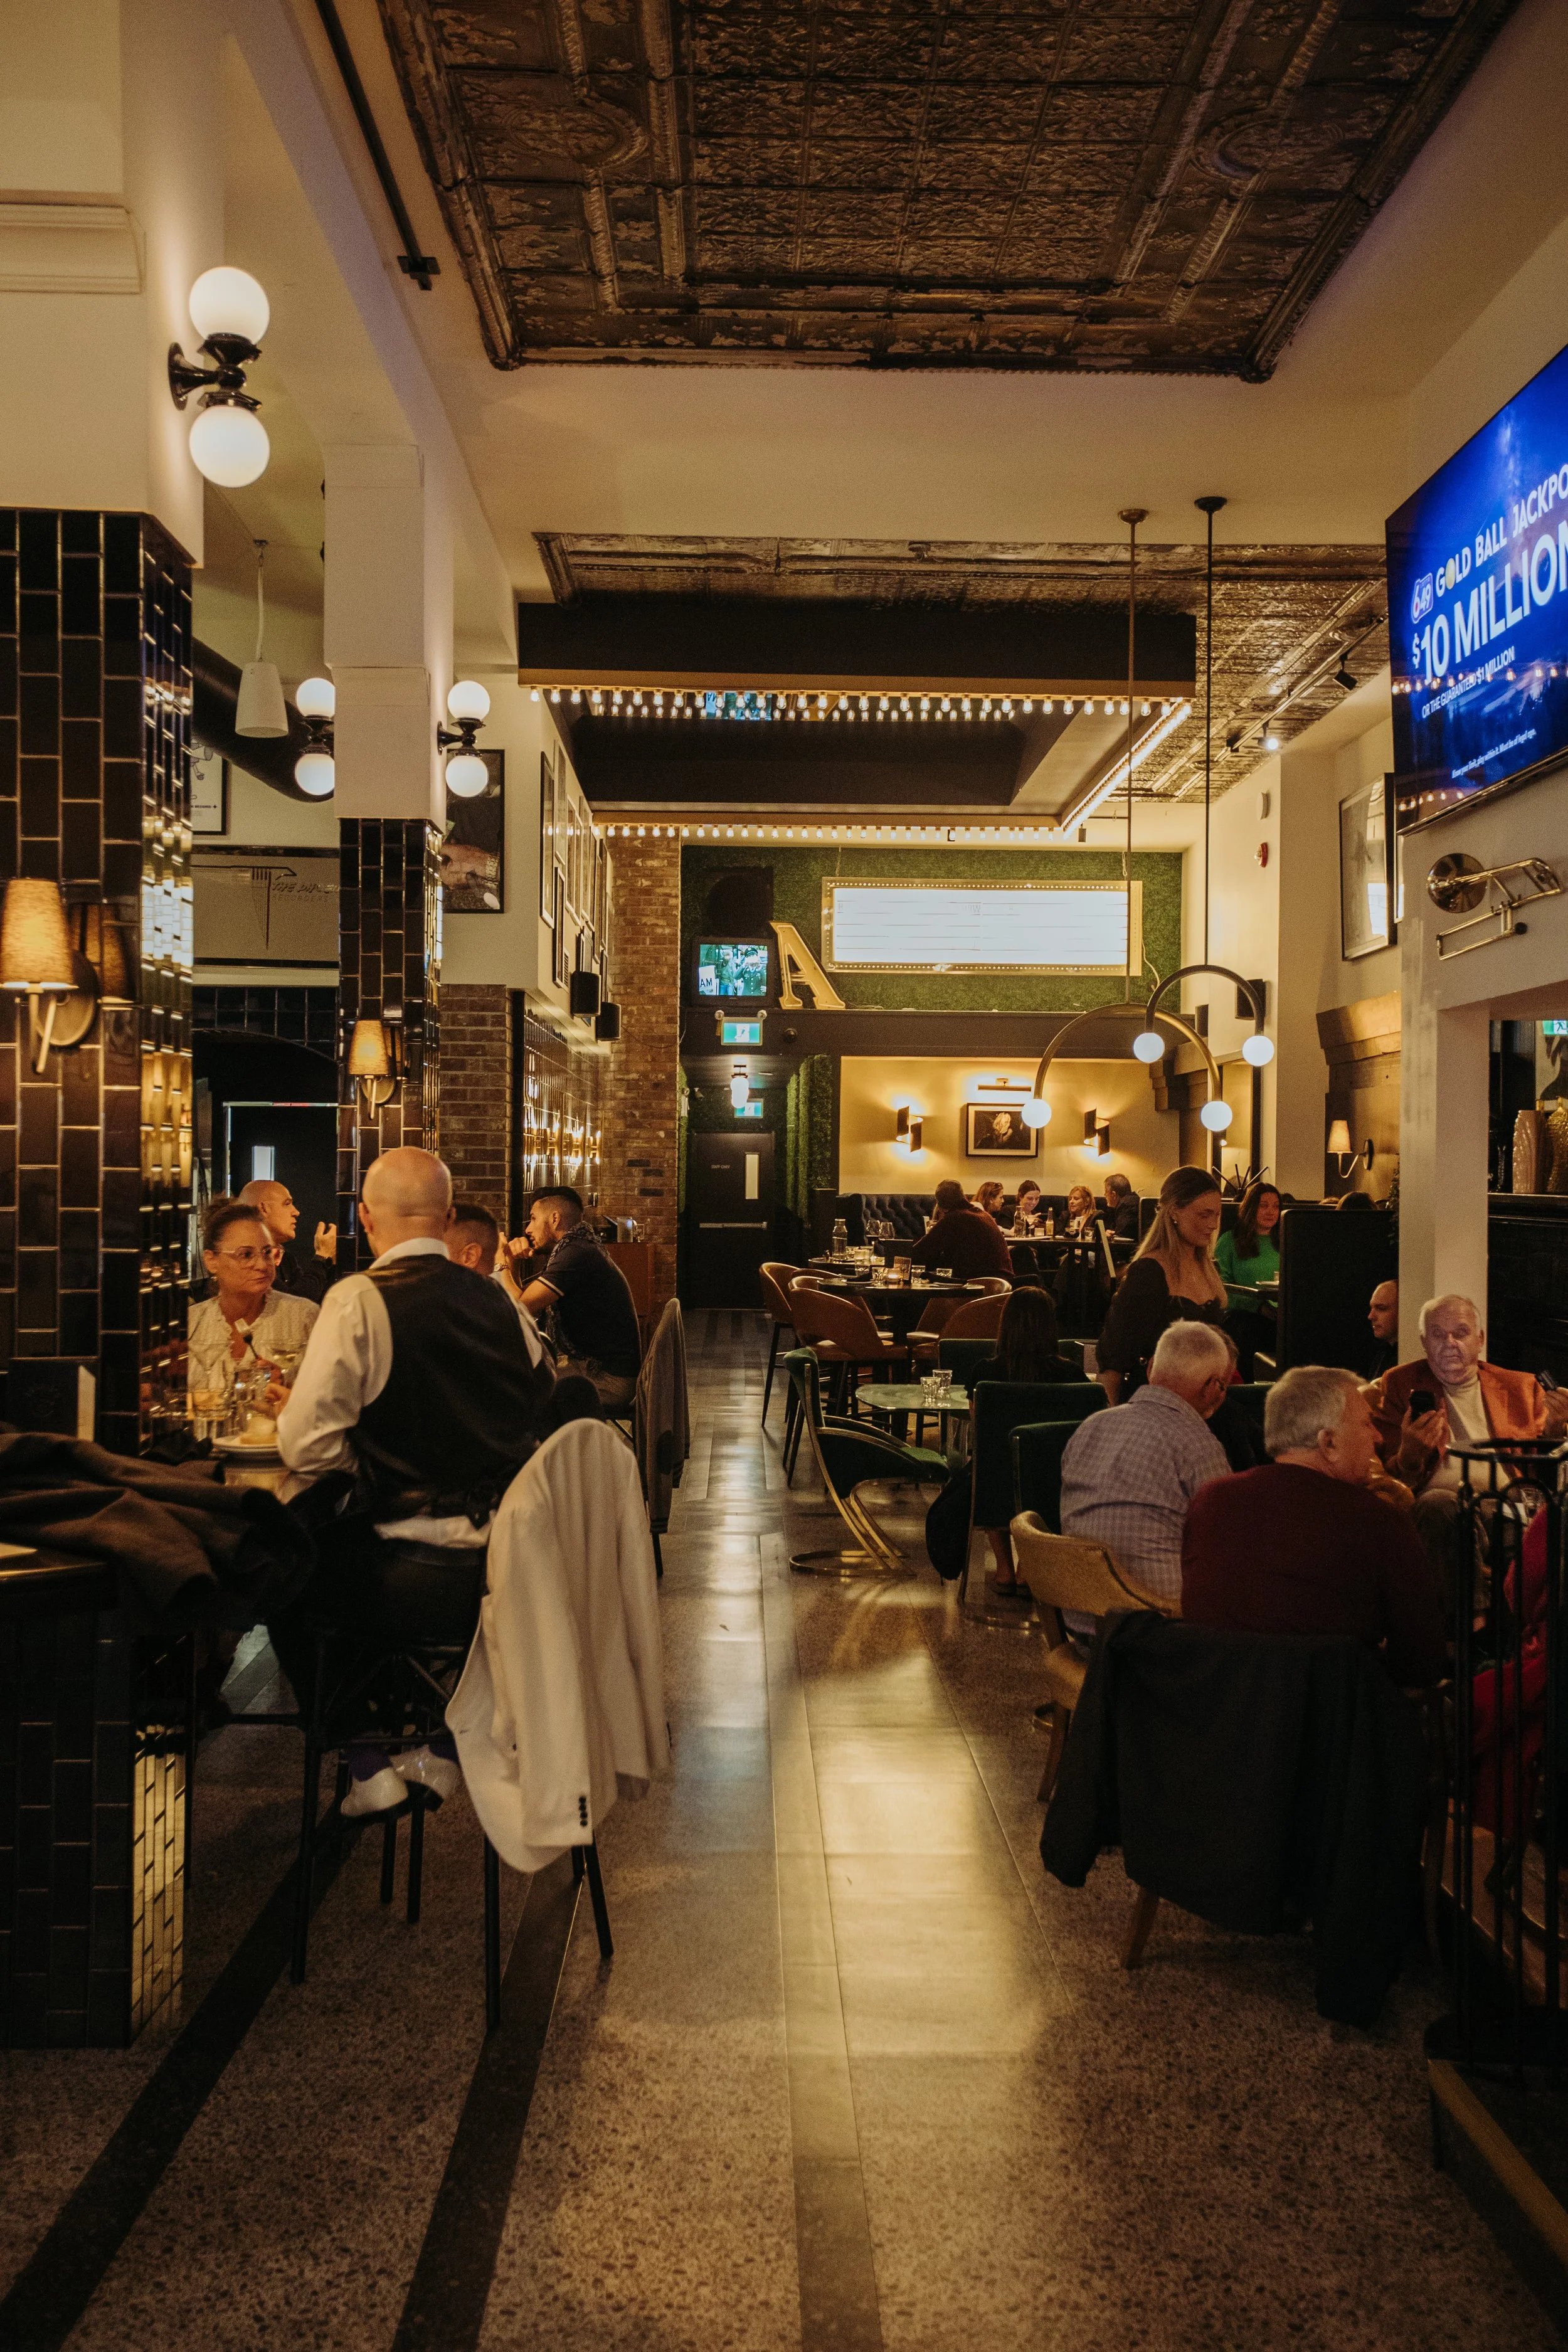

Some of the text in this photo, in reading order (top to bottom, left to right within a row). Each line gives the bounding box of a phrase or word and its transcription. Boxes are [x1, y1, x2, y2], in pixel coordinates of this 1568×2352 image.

[1436, 547, 1471, 597] GOLD
[1475, 517, 1507, 568] BALL
[1412, 614, 1449, 686] $10
[1422, 702, 1431, 718] OR
[1430, 696, 1441, 713] THE
[1476, 666, 1485, 685] $1
[1485, 645, 1515, 677] MILLION
[700, 978, 712, 988] AM
[769, 921, 845, 1010] A
